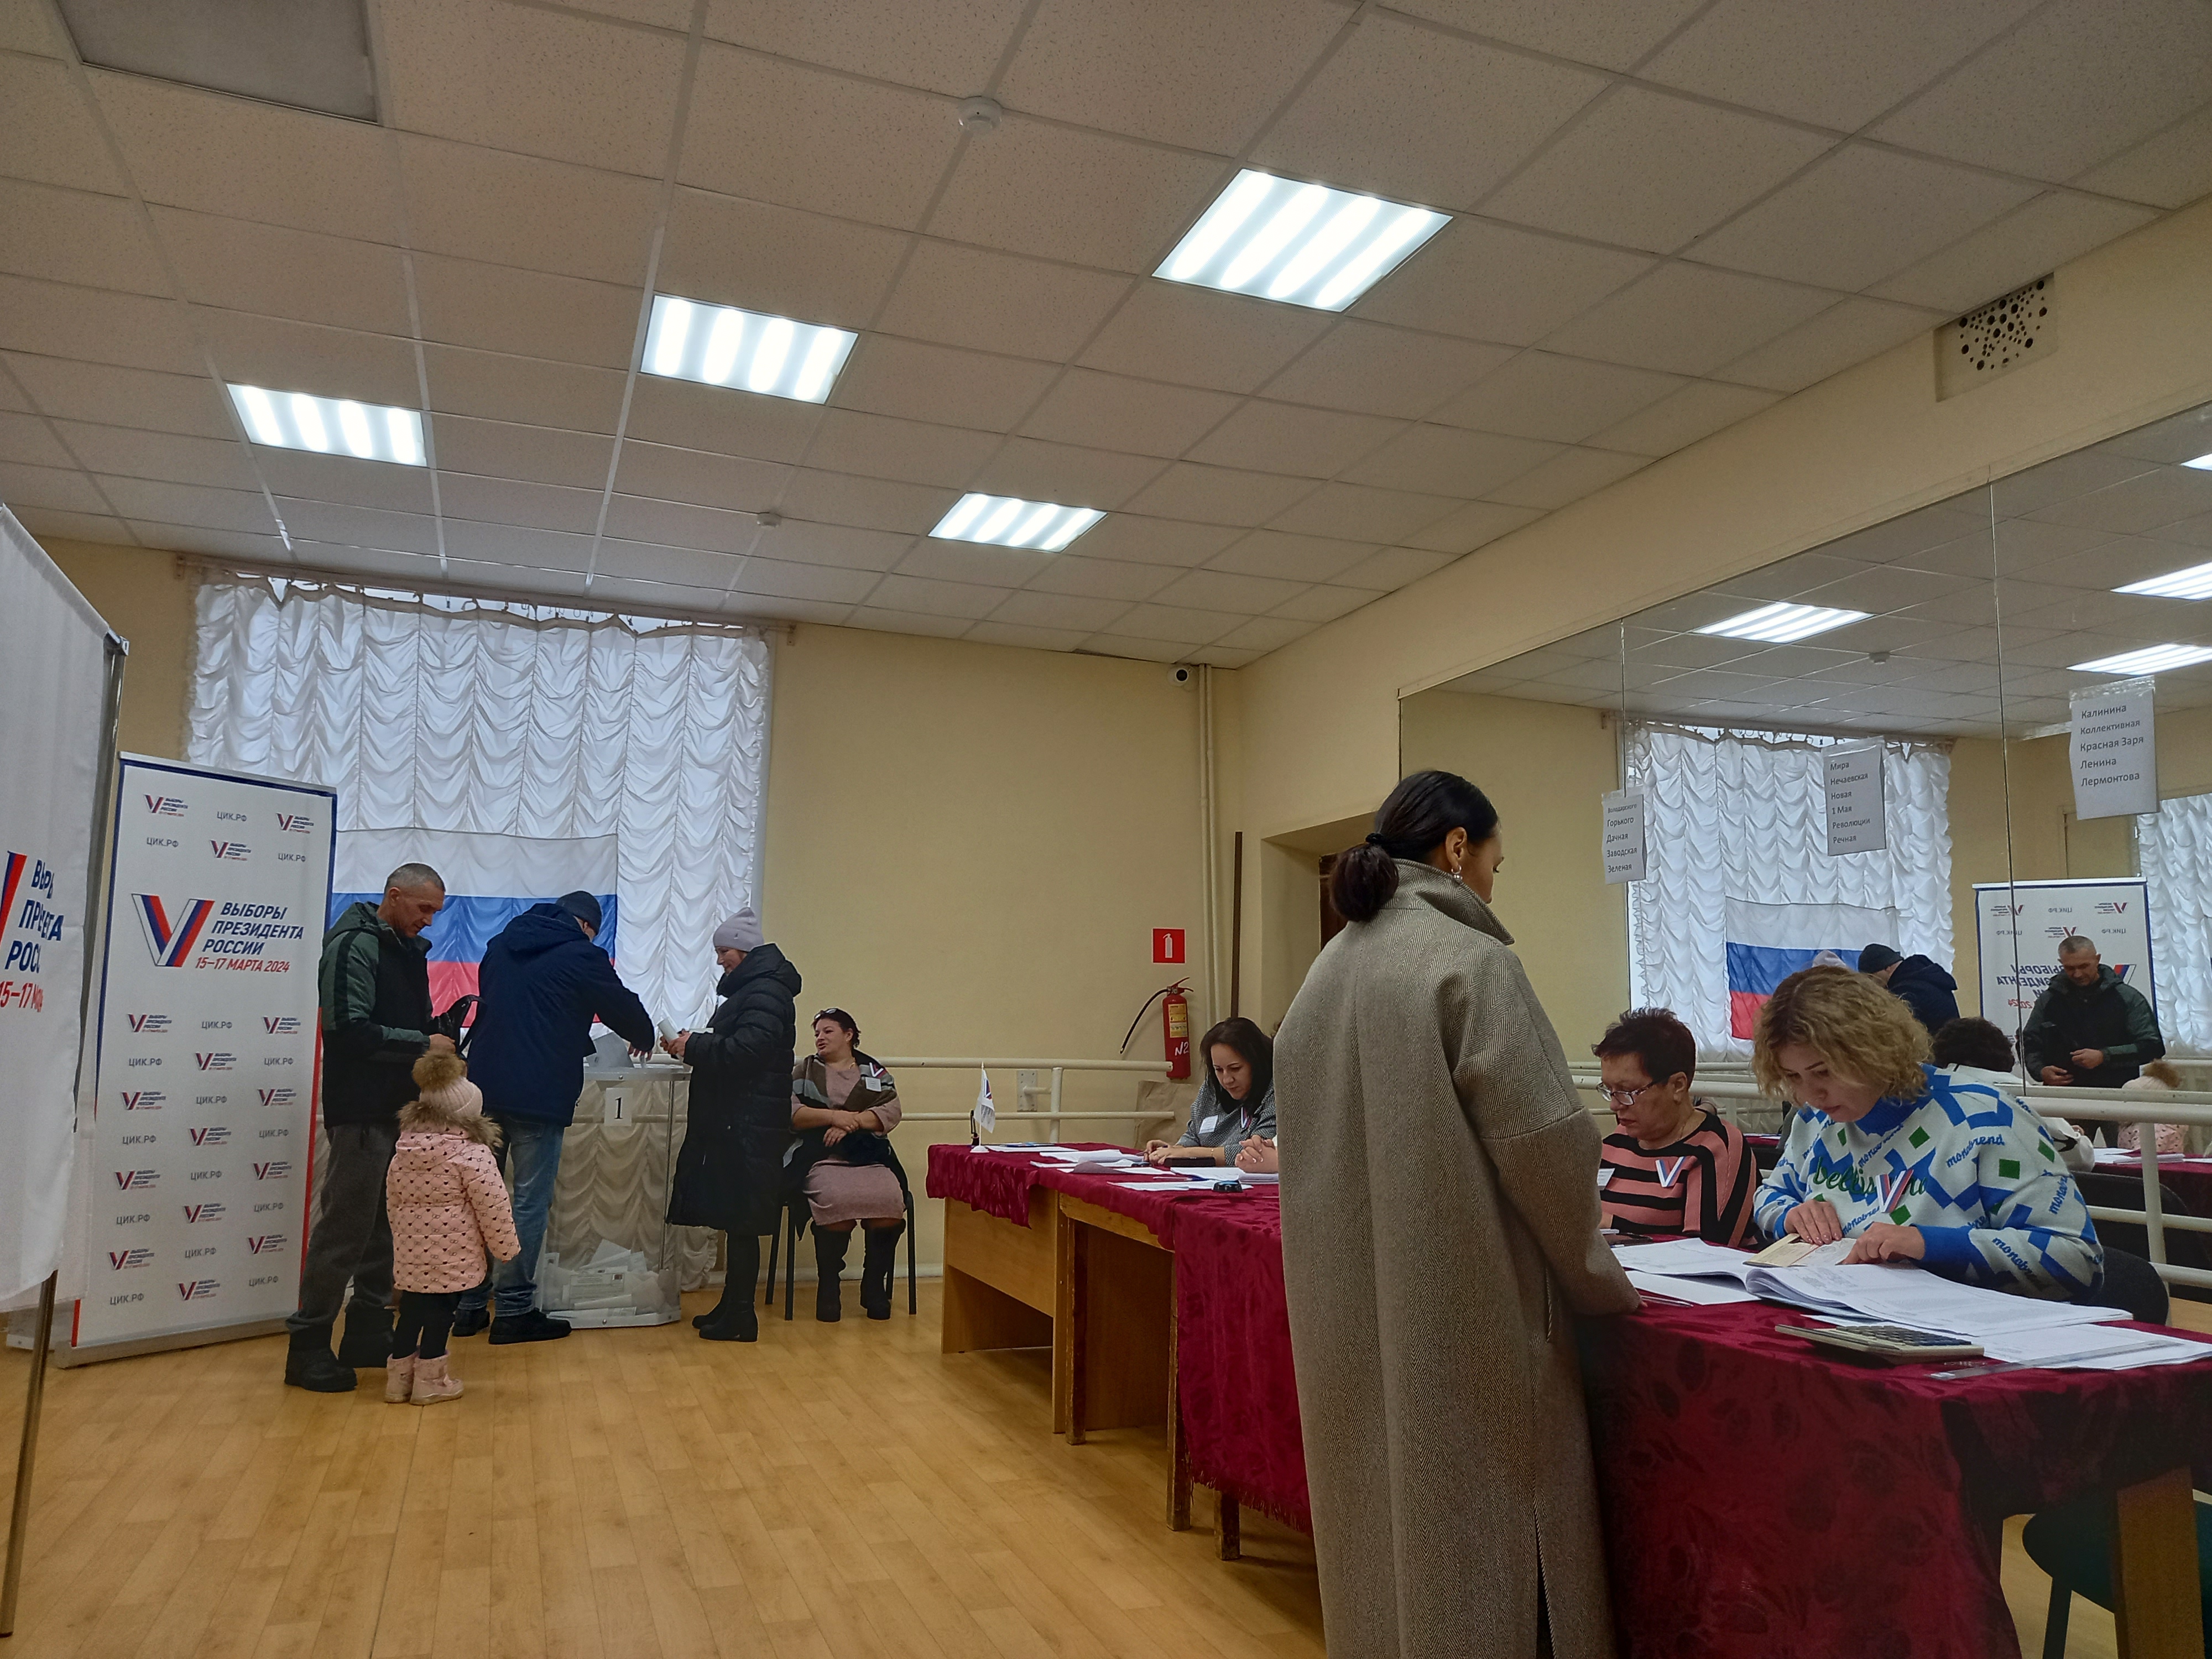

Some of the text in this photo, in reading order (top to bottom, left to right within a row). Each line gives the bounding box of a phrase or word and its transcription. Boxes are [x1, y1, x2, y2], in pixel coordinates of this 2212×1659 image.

[2081, 705, 2127, 719] Калинина
[2080, 720, 2140, 735] Коллективная
[2080, 736, 2144, 753] Красная Заря
[1830, 762, 1849, 771] Мира
[2080, 758, 2117, 770] Ленина
[1830, 773, 1868, 786] Нечаевская
[2081, 773, 2140, 787] Лермонтова
[1831, 791, 1852, 800] Новая
[1837, 805, 1852, 814] Мая
[1607, 817, 1634, 828] Горького
[1832, 818, 1870, 830] Революции
[1606, 833, 1629, 844] Дачная
[1833, 835, 1857, 844] Речная
[1606, 847, 1637, 858] Заводская
[1608, 864, 1632, 873] Зеленая
[220, 902, 288, 920] ВЫБОРЫ
[211, 920, 304, 940] ПРЕЗИДЕНТА
[202, 938, 265, 955] РОССИИ
[226, 958, 264, 972] МАРТА
[263, 961, 290, 973] 2024
[614, 1097, 623, 1120] 1
